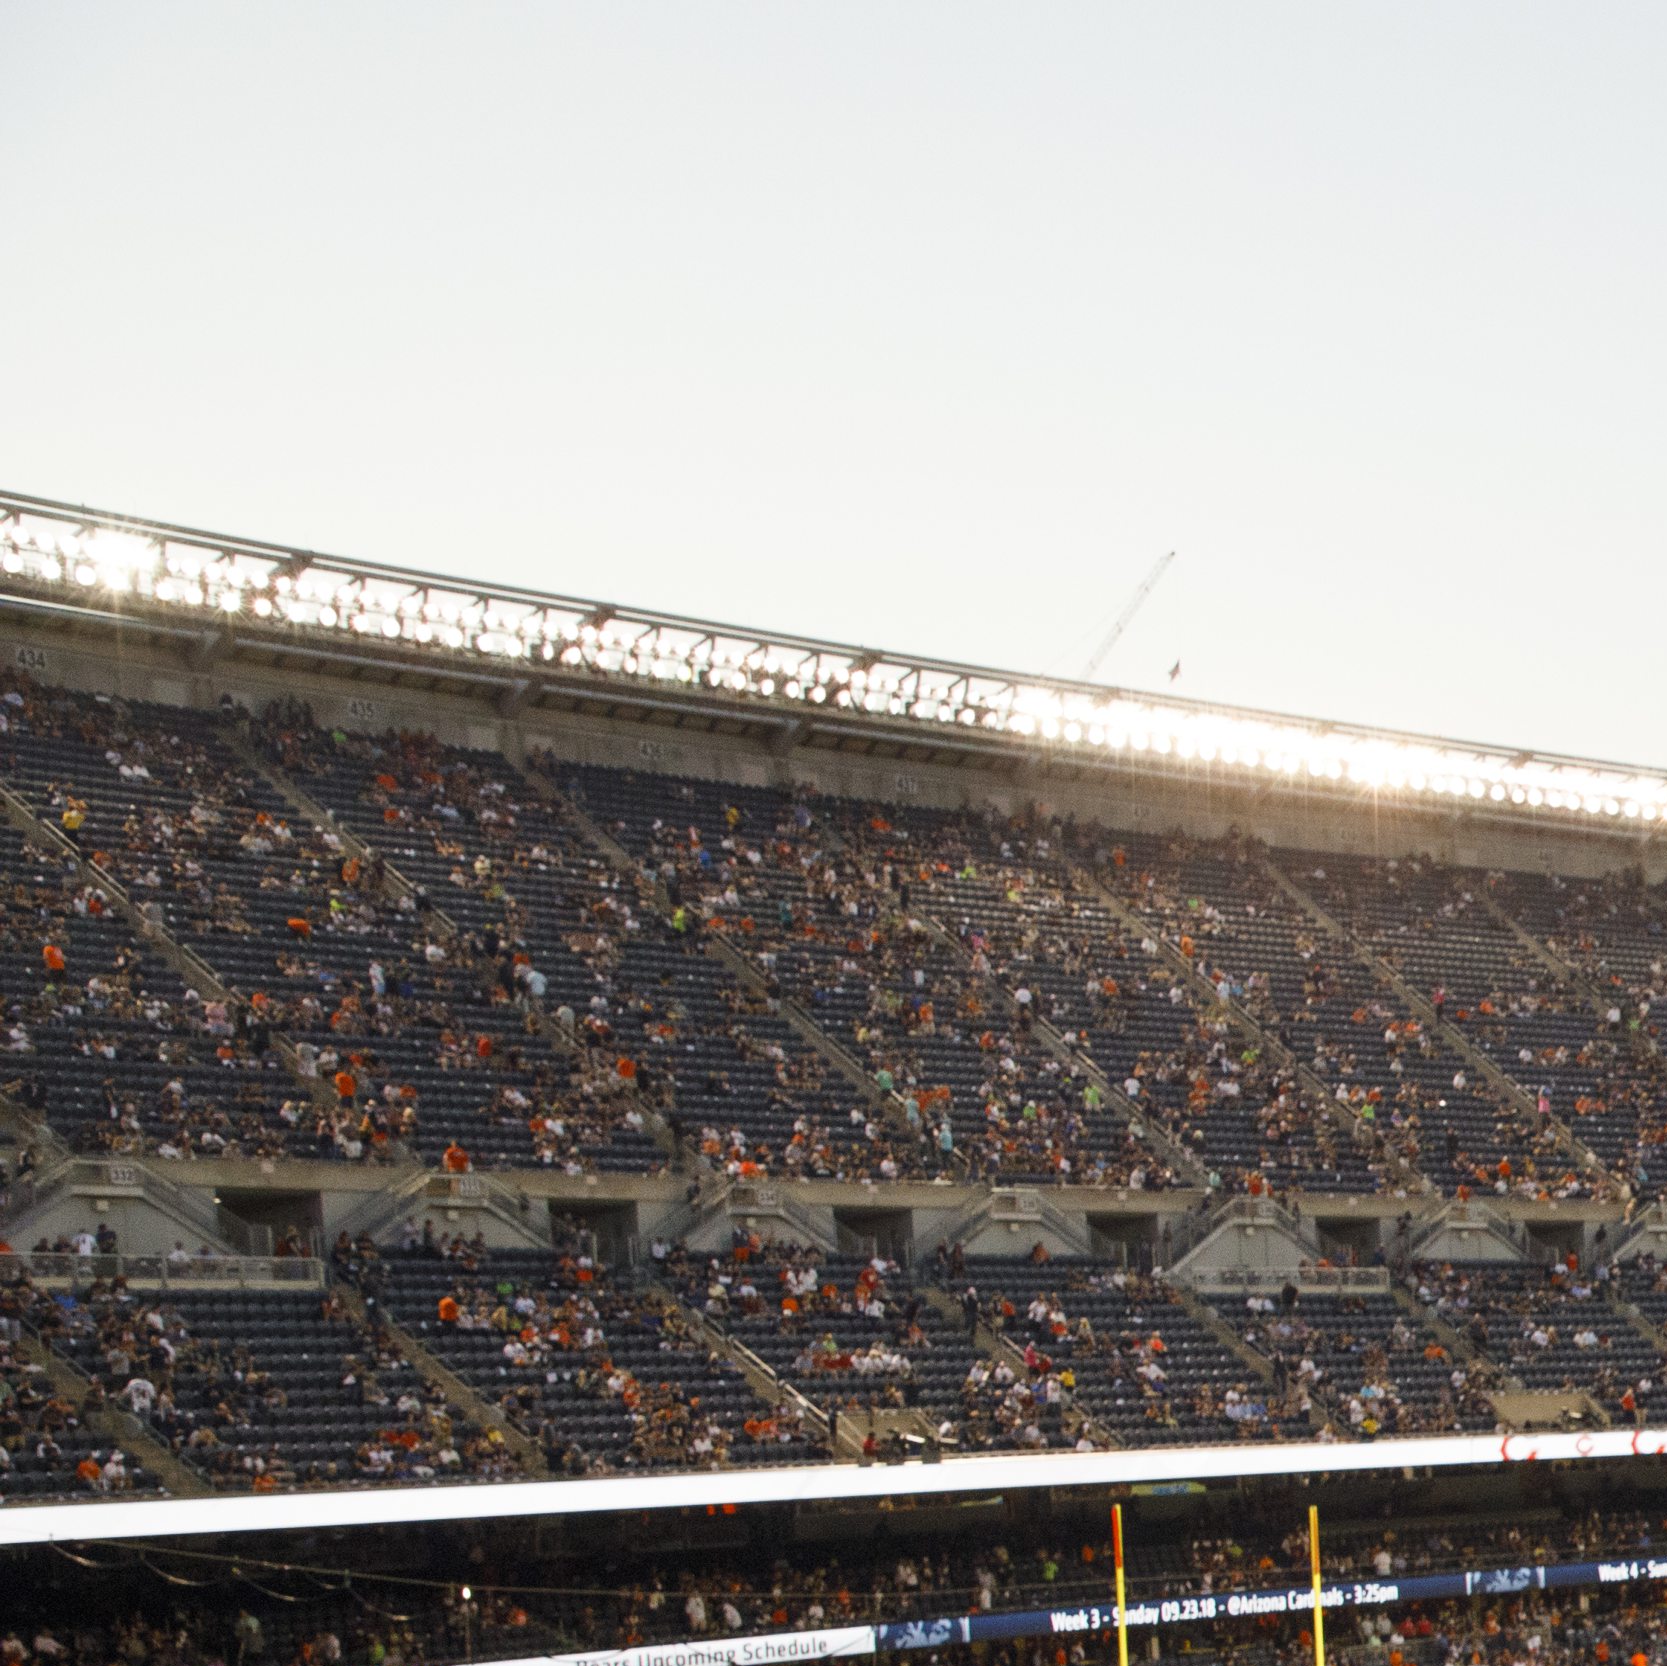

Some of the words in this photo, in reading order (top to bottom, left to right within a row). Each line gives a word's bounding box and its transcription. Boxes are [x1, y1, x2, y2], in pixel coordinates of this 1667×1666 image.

[17, 649, 45, 668] 434
[1050, 1610, 1088, 1632] Week
[1090, 1609, 1100, 1627] 3
[1113, 1604, 1159, 1627] Snday
[1161, 1598, 1216, 1621] 09.23.18
[1227, 1592, 1286, 1616] @Arizona
[1354, 1584, 1398, 1603] 3:25pm
[742, 1637, 828, 1662] Schedule
